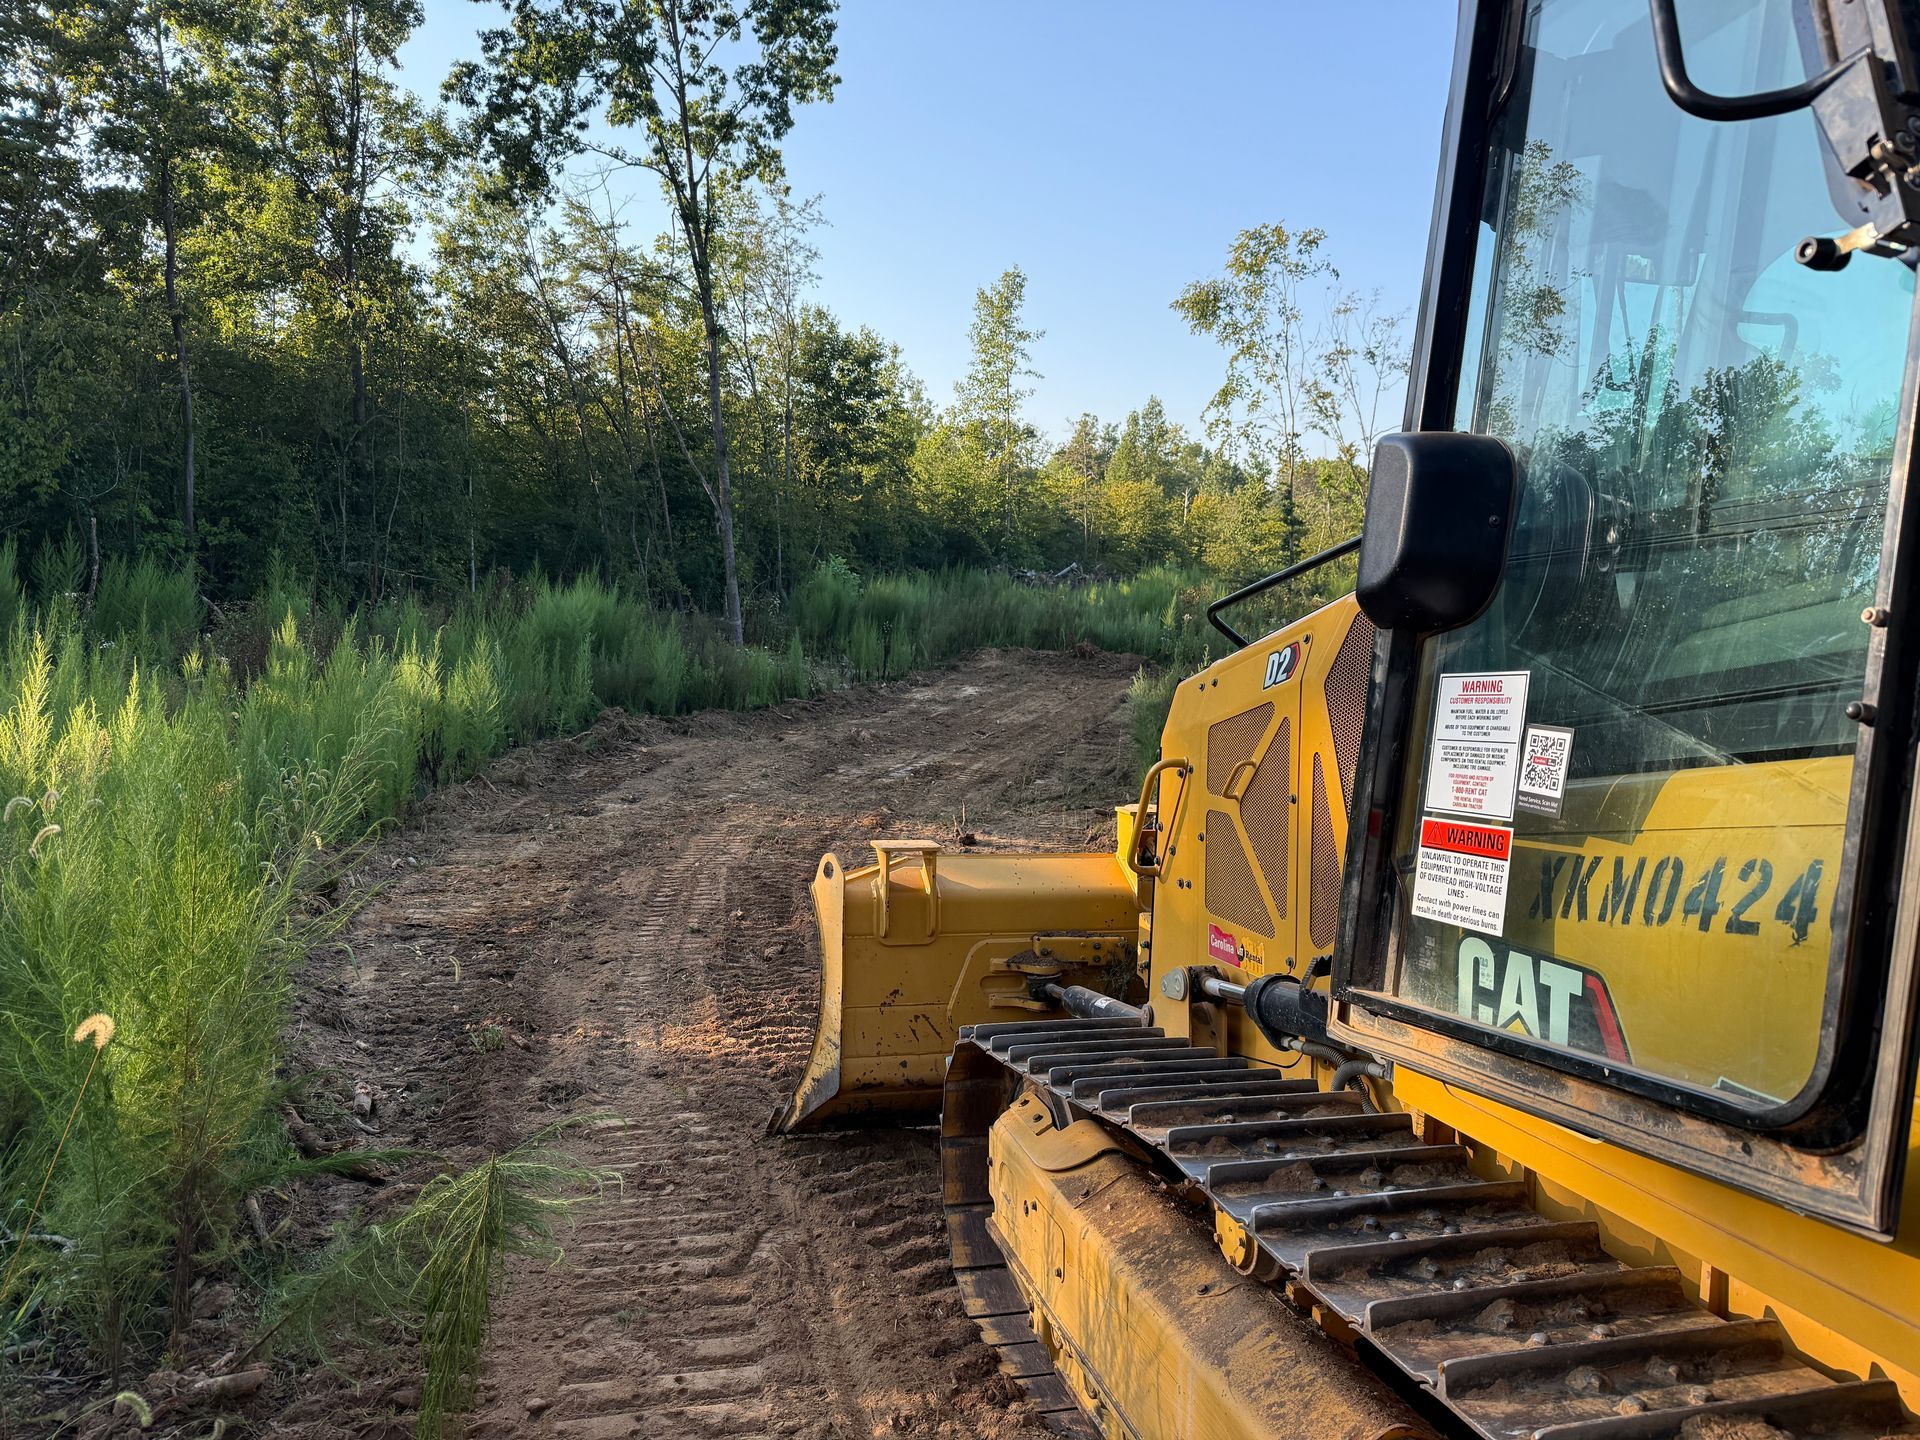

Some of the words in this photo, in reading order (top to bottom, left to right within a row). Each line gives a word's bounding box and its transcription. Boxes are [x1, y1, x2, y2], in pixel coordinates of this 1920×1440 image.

[1264, 647, 1291, 688] D2
[1462, 680, 1503, 693] WARNING
[1448, 828, 1504, 851] WARNING
[1421, 861, 1452, 873] EQUIPMENT
[1454, 867, 1475, 879] WITHIN
[1477, 871, 1487, 881] TEN
[1490, 874, 1503, 884] FEET
[1422, 851, 1451, 863] UNLAWFUL
[1454, 856, 1460, 864] TO
[1462, 858, 1489, 870] OPERATE
[1491, 863, 1505, 872] THIS
[1420, 871, 1426, 880] OF
[1428, 873, 1457, 886] OVERHEAD
[1459, 880, 1502, 895] HIGH-VOLTAGE
[1448, 888, 1464, 898] LINES
[1416, 905, 1430, 913] result
[1431, 907, 1436, 915] in
[1438, 909, 1452, 919] death
[1460, 915, 1480, 926] serious
[1481, 919, 1498, 931] burns.
[1418, 893, 1437, 905] Contact
[1439, 899, 1451, 908] with
[1452, 902, 1471, 911] power
[1473, 906, 1486, 916] lines
[1488, 911, 1499, 919] can
[1210, 934, 1235, 955] Carolina
[1245, 950, 1263, 965] Rental
[1457, 936, 1583, 1047] CAT
